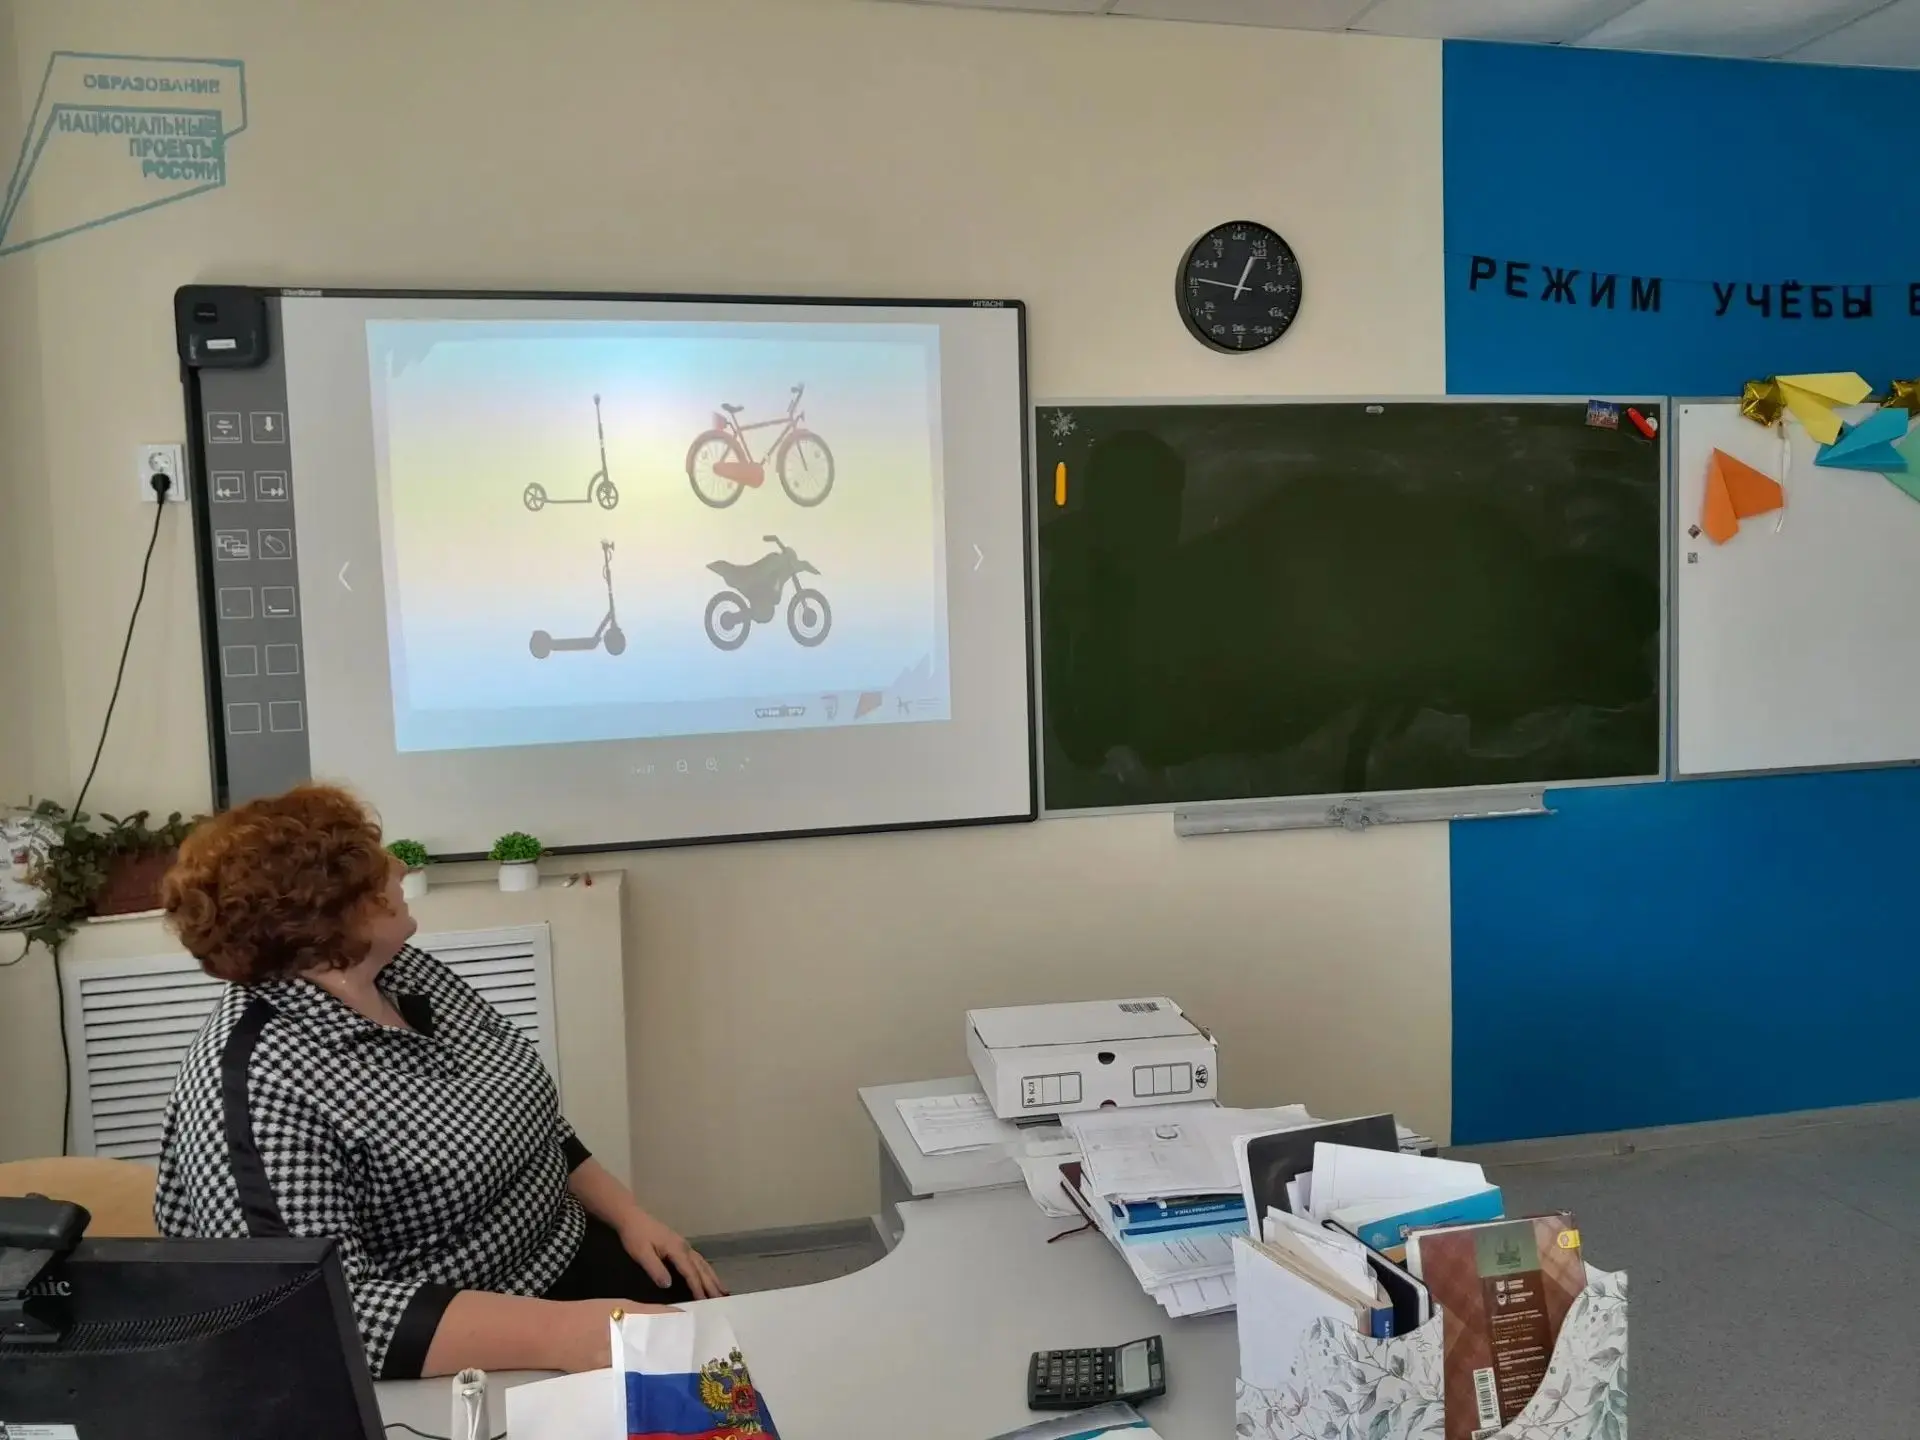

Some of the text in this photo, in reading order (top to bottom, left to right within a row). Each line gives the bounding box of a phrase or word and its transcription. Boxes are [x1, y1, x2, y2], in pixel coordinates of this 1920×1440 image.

[83, 74, 220, 94] ОБРАЗОВАНИЕ
[142, 160, 220, 181] РОССИИ
[1469, 255, 1663, 313] РЕЖИМ
[1713, 280, 1873, 319] УЧЁБЫ
[26, 1274, 73, 1297] nic
